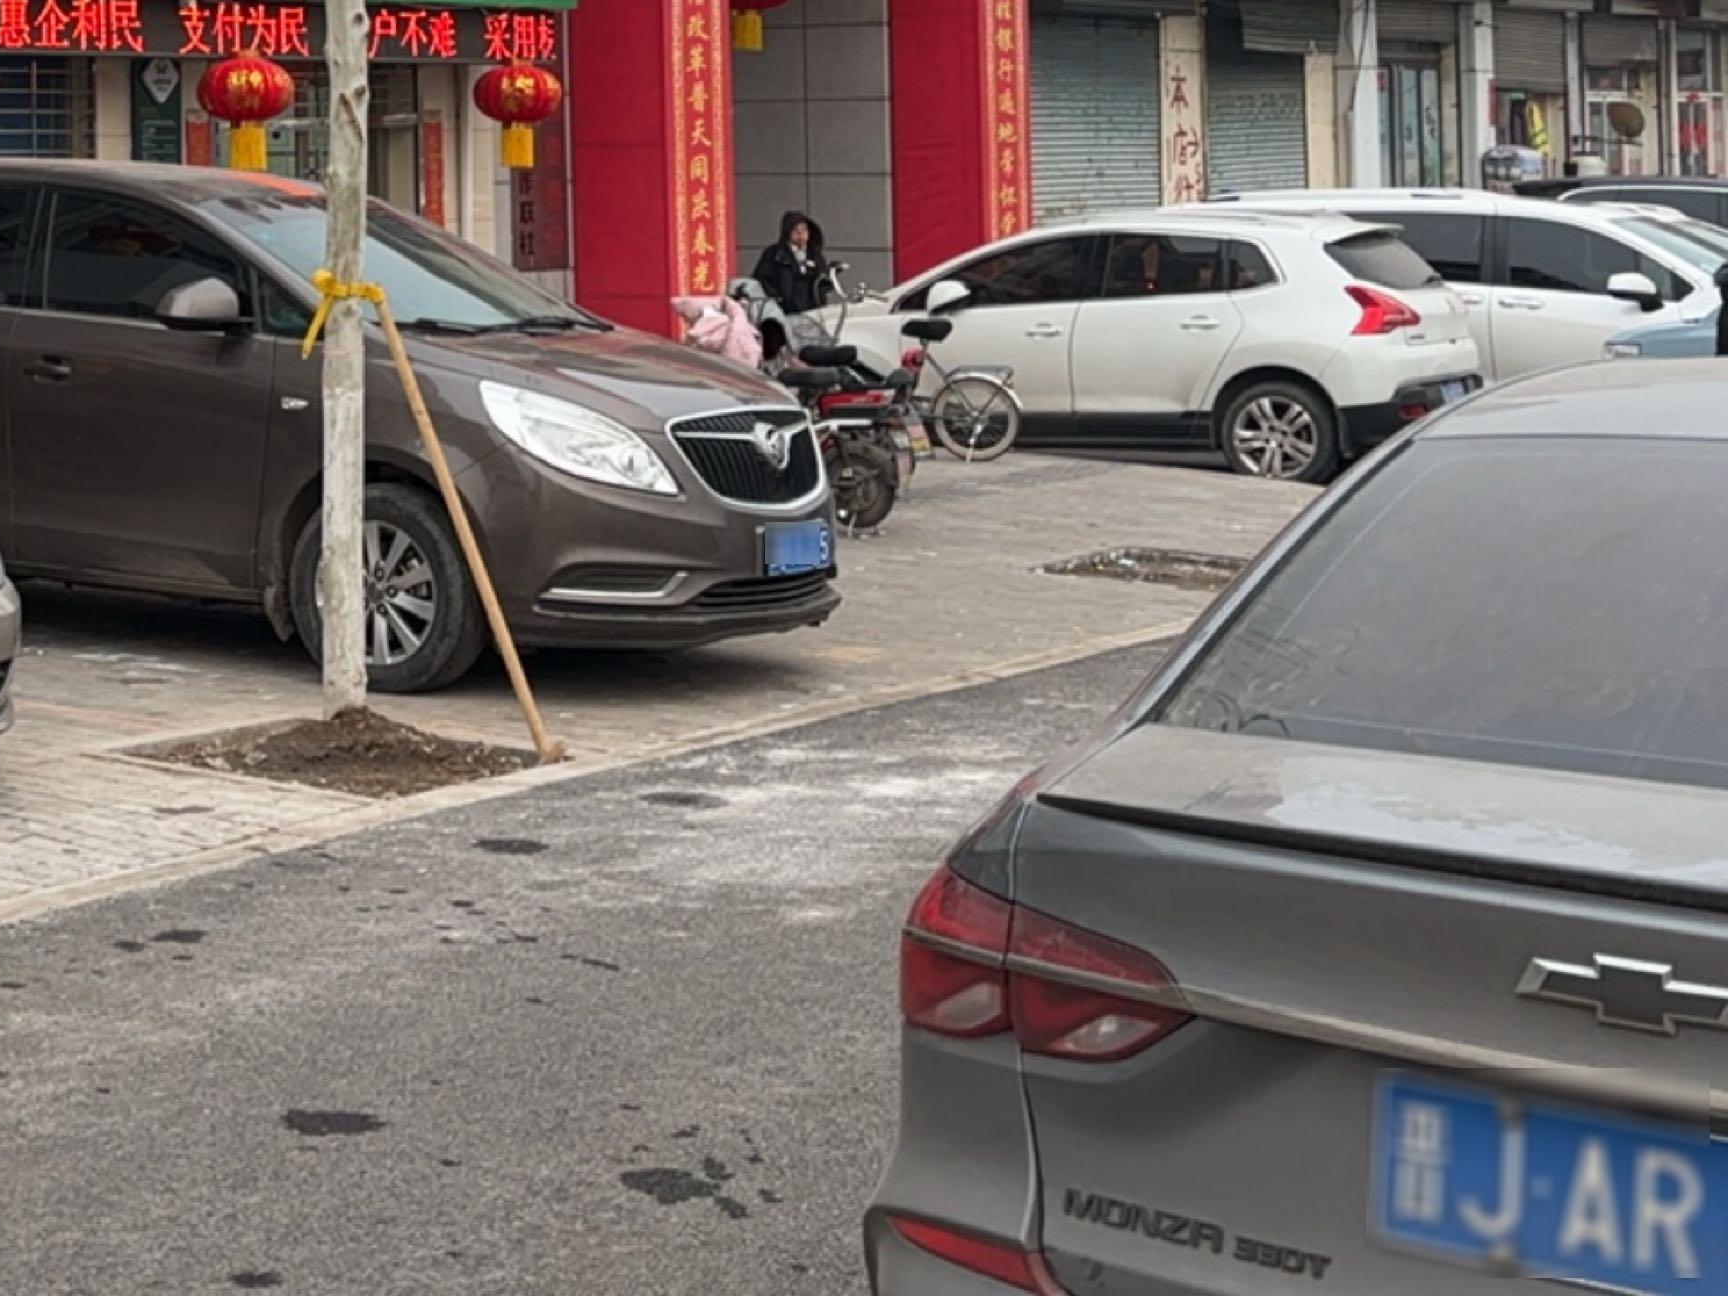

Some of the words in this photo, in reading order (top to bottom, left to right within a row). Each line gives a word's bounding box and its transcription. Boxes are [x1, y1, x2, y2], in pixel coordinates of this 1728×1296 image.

[179, 1, 311, 58] 支付为民
[368, 8, 457, 60] 户不难
[1063, 1187, 1225, 1256] MONZA
